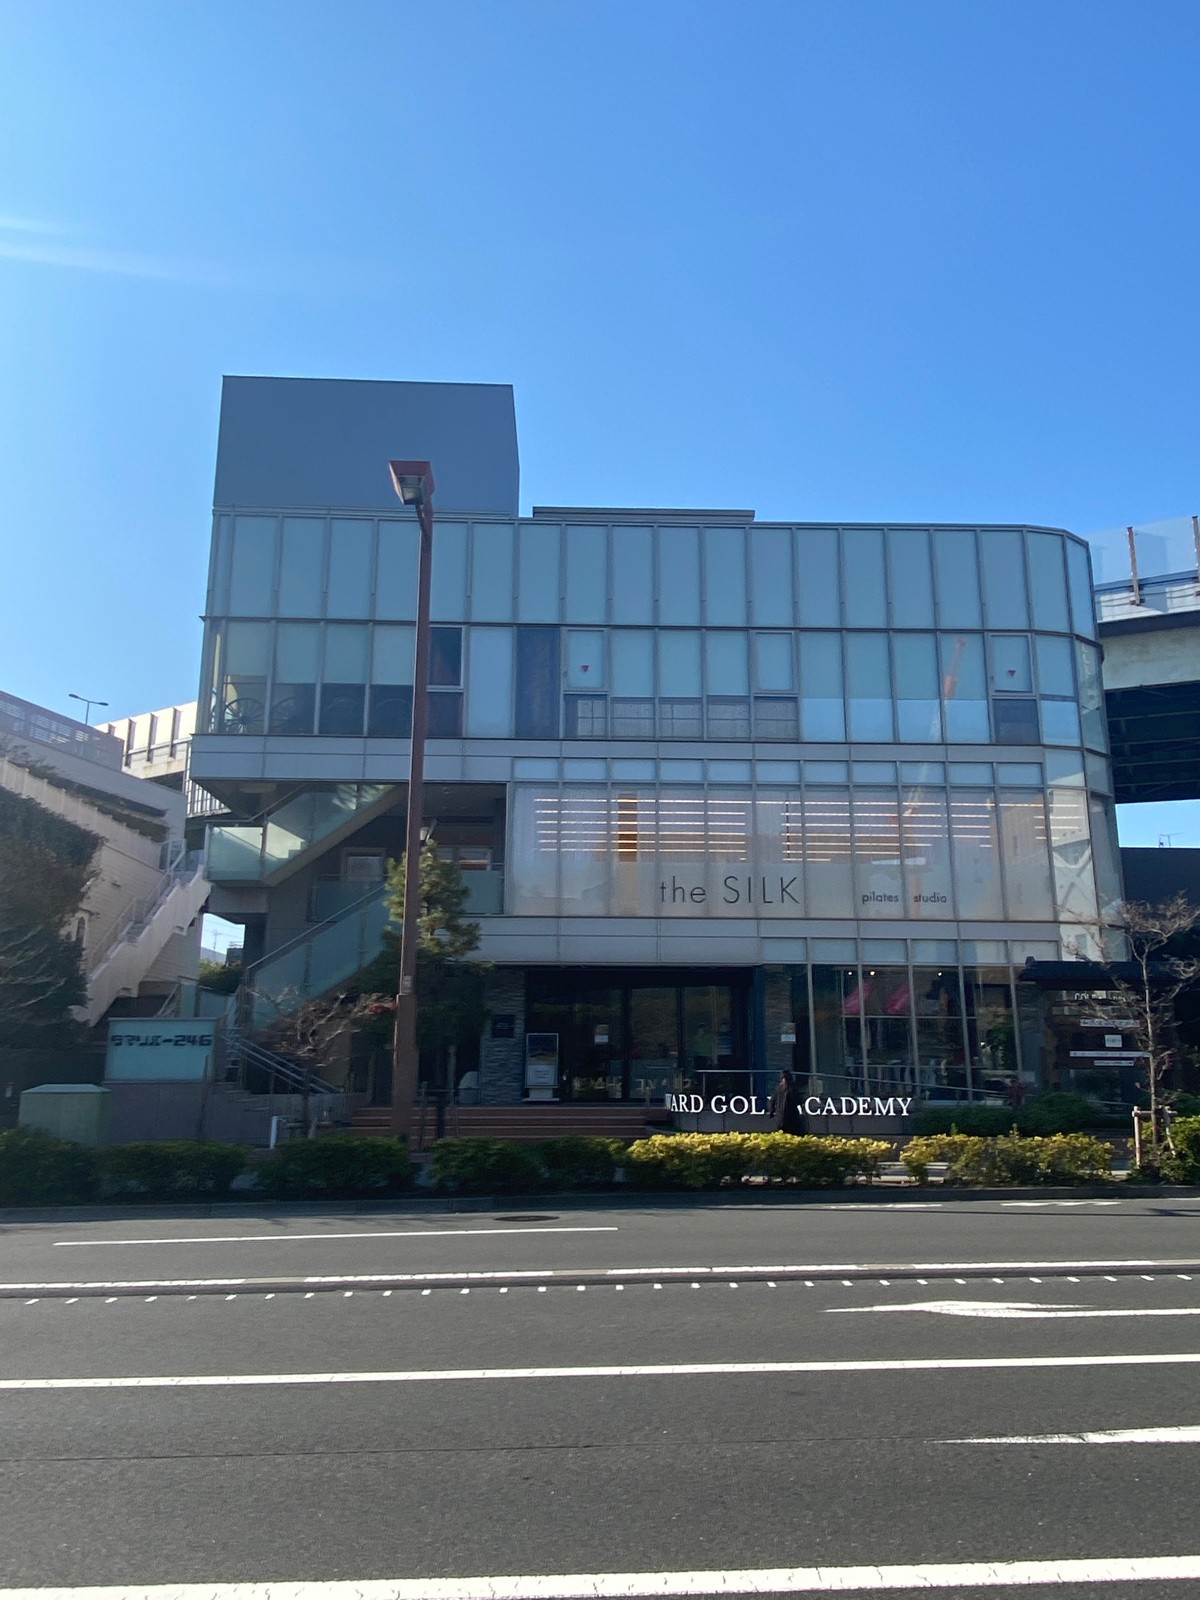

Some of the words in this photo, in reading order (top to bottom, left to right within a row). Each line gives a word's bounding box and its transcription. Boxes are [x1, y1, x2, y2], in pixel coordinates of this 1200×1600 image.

[659, 875, 706, 904] the
[722, 875, 800, 904] SILK
[861, 891, 900, 905] pilates
[913, 892, 947, 903] studio
[710, 1094, 777, 1115] GOL
